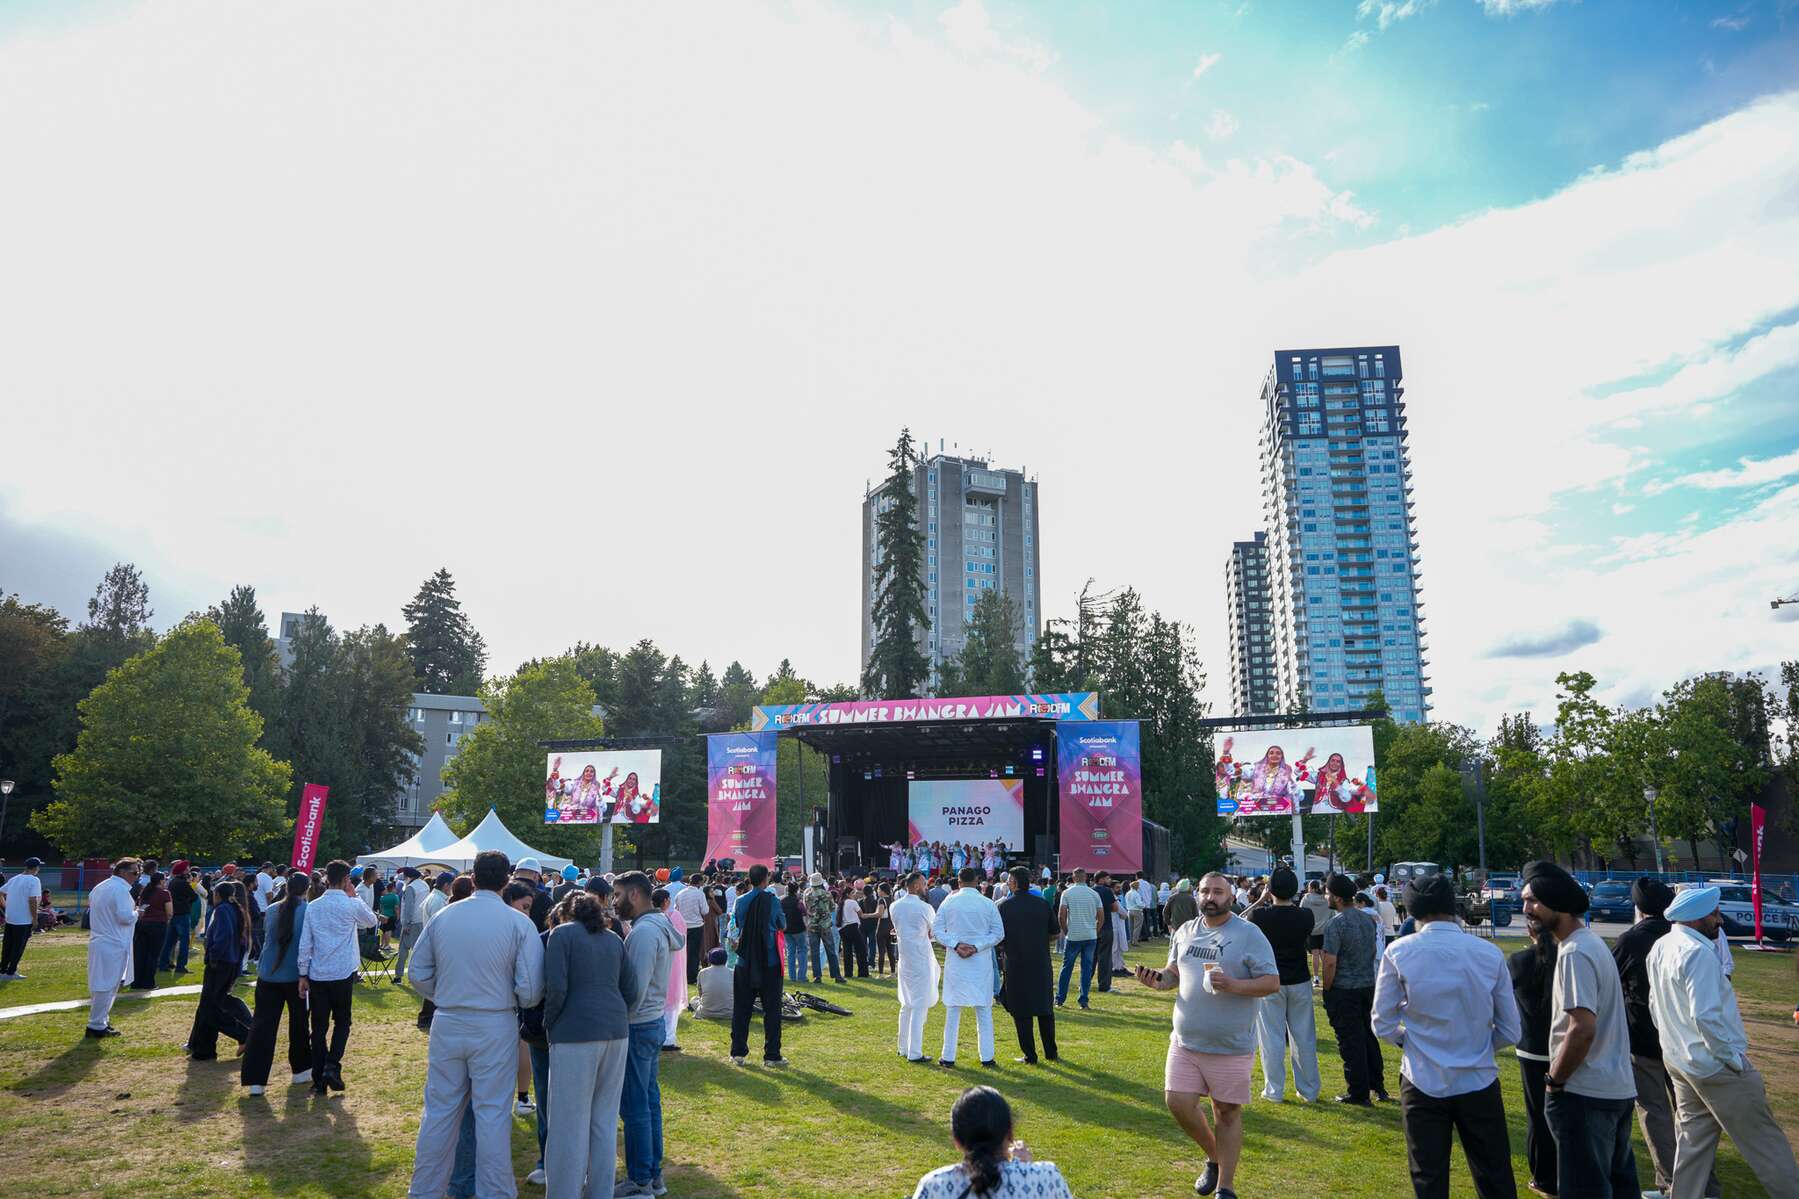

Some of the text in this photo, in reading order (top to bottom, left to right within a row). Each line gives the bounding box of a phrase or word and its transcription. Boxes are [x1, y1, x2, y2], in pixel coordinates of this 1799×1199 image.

[819, 702, 1021, 724] SUMMER BHANGRA JAM
[1074, 771, 1125, 782] SUMMER
[722, 778, 762, 788] SUMMER
[1070, 783, 1130, 795] BHANGRA
[718, 790, 766, 800] BHANGRA
[733, 801, 751, 811] JAM
[1088, 796, 1112, 807] JAM
[942, 806, 991, 815] PANAGO
[949, 816, 984, 825] PIZZA
[297, 796, 321, 868] Scotiabank
[1736, 912, 1780, 923] POCE
[1185, 944, 1218, 960] PUMA
